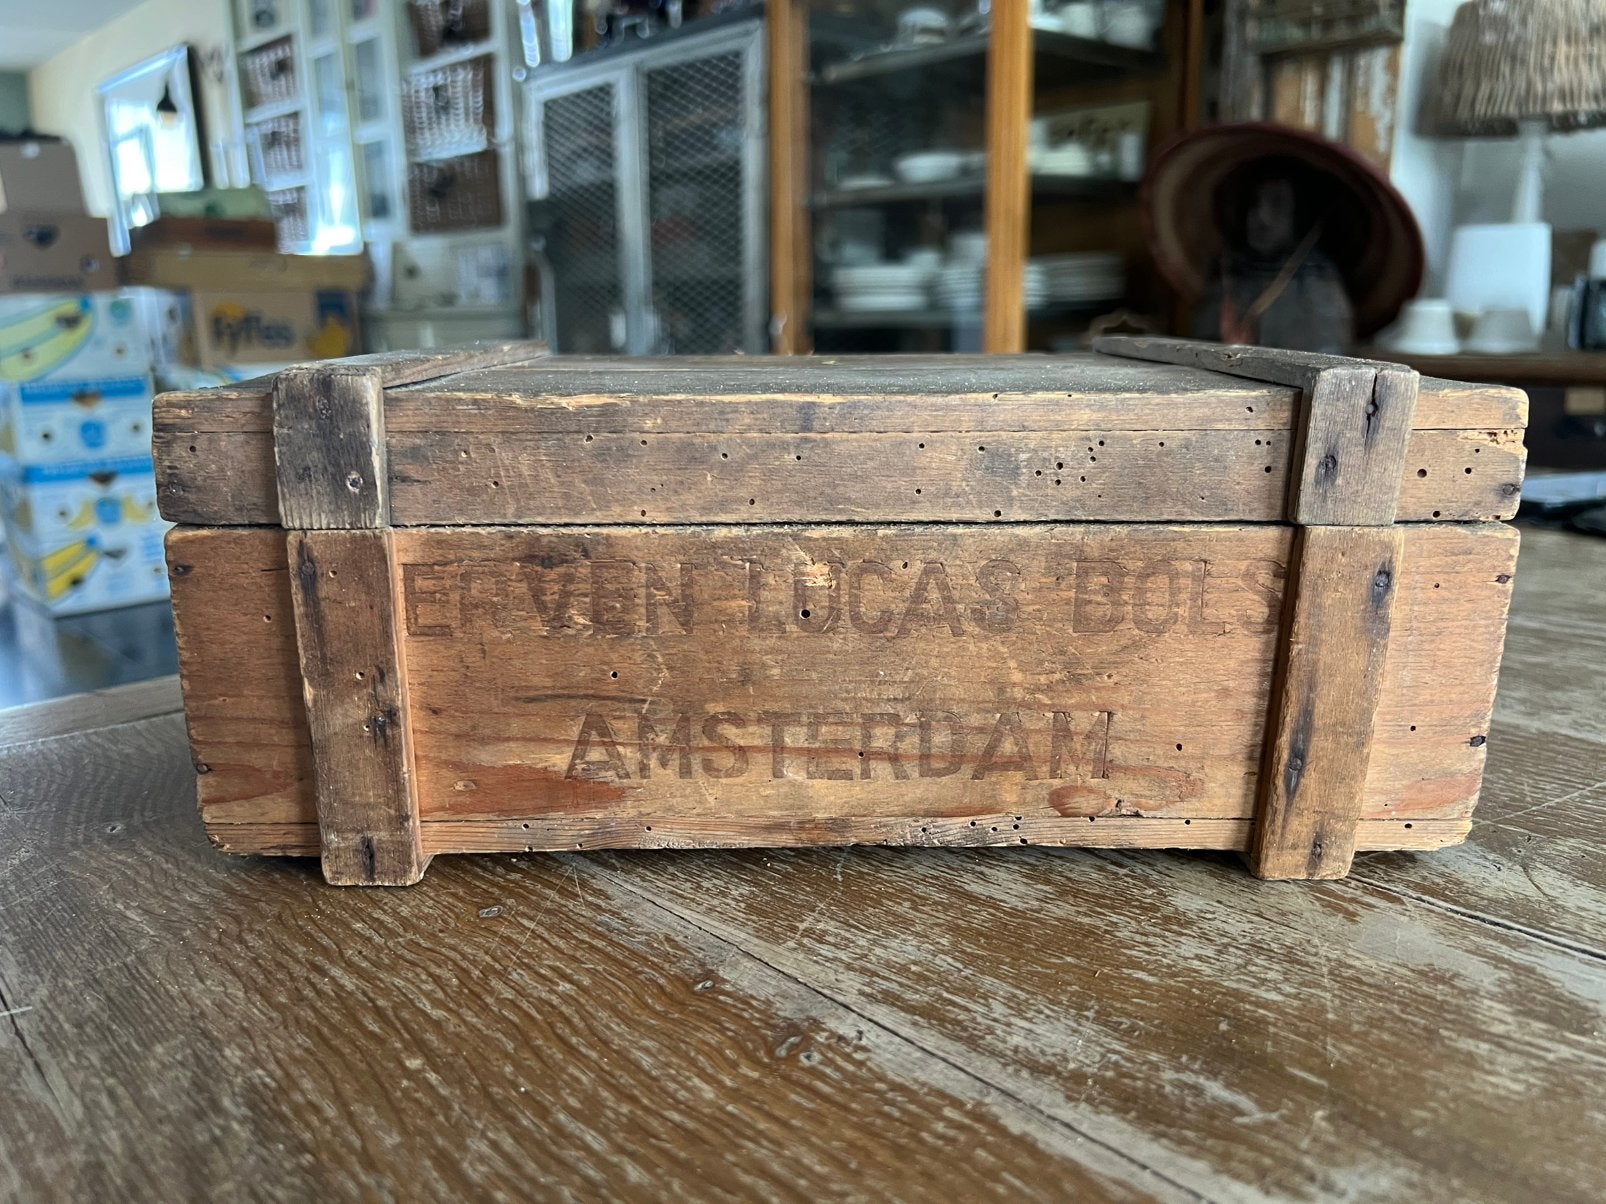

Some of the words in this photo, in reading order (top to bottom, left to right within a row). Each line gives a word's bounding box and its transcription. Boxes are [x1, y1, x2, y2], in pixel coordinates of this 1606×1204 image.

[403, 559, 698, 637] ERVEN
[746, 558, 1021, 637] LUCAS
[1073, 559, 1286, 635] BOLS
[564, 710, 1112, 781] AMSTERDAM
